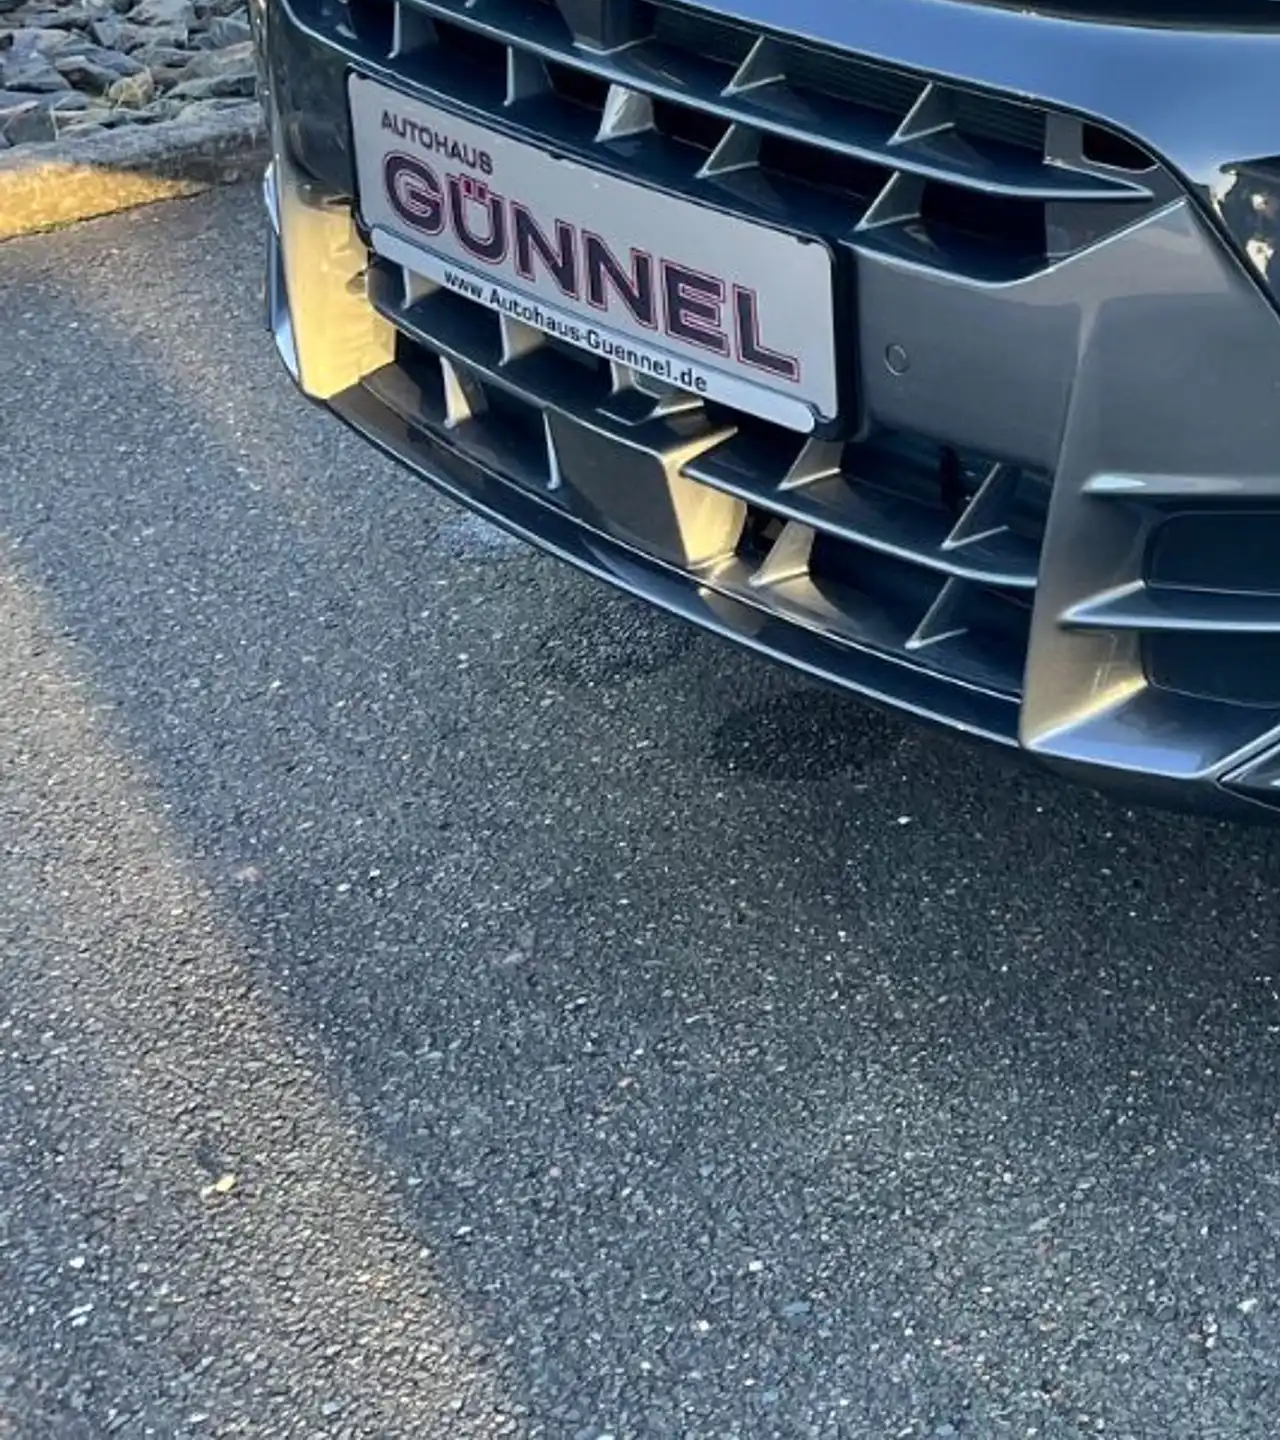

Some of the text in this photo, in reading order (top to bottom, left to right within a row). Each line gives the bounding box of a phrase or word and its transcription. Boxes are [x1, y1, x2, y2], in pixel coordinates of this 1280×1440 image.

[381, 109, 493, 175] AUTOHAUS
[383, 149, 801, 383] GÜNNEL
[443, 268, 708, 392] www.Autohaus-Guennel.de
